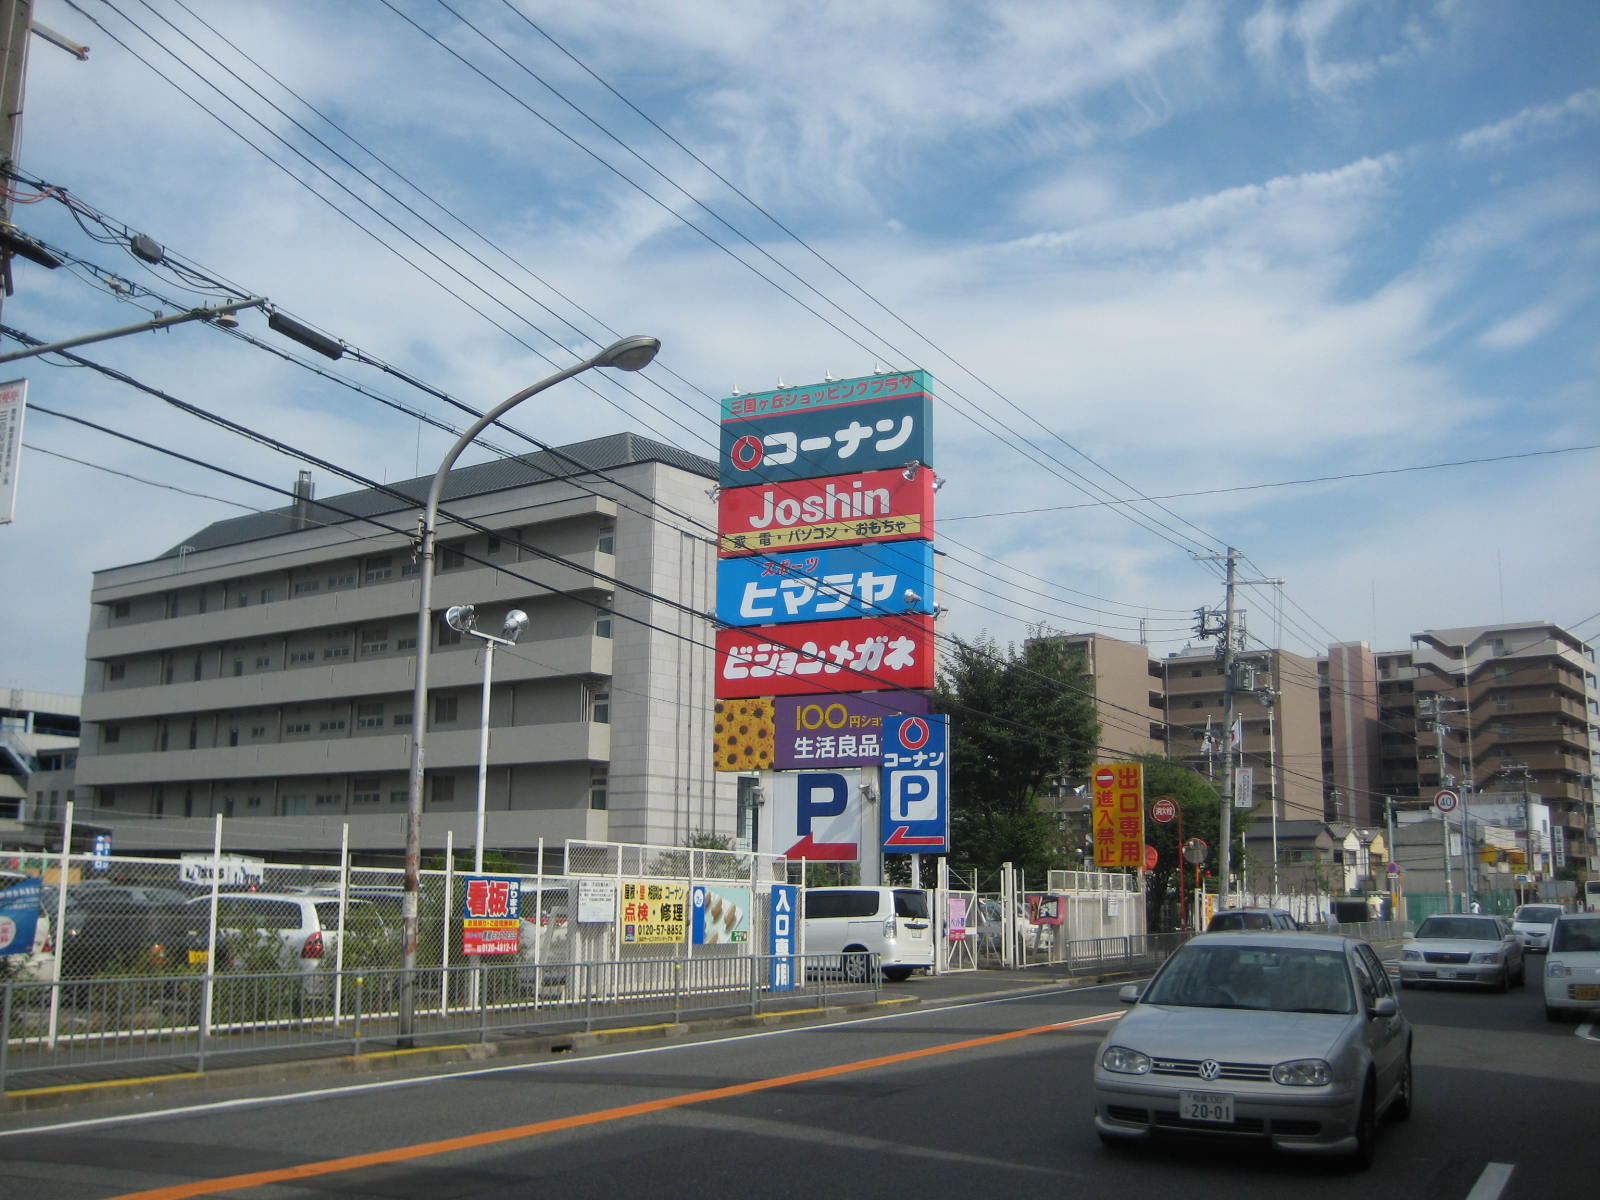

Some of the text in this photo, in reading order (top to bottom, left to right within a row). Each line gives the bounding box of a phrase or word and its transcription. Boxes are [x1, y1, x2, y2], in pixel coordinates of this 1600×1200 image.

[762, 415, 914, 467] コーナン
[749, 481, 890, 529] Joshin
[761, 557, 820, 577] スポーツ
[739, 571, 898, 618] ヒマラヤ
[723, 635, 916, 680] ビジョンメガネ
[884, 751, 944, 768] コーナン
[797, 773, 848, 836] P
[900, 775, 930, 818] P
[1118, 768, 1141, 864] 出口専用
[1440, 797, 1452, 806] 40
[1096, 790, 1116, 863] 進入禁止
[467, 880, 510, 917] 看板
[624, 902, 684, 922] 点検・修理
